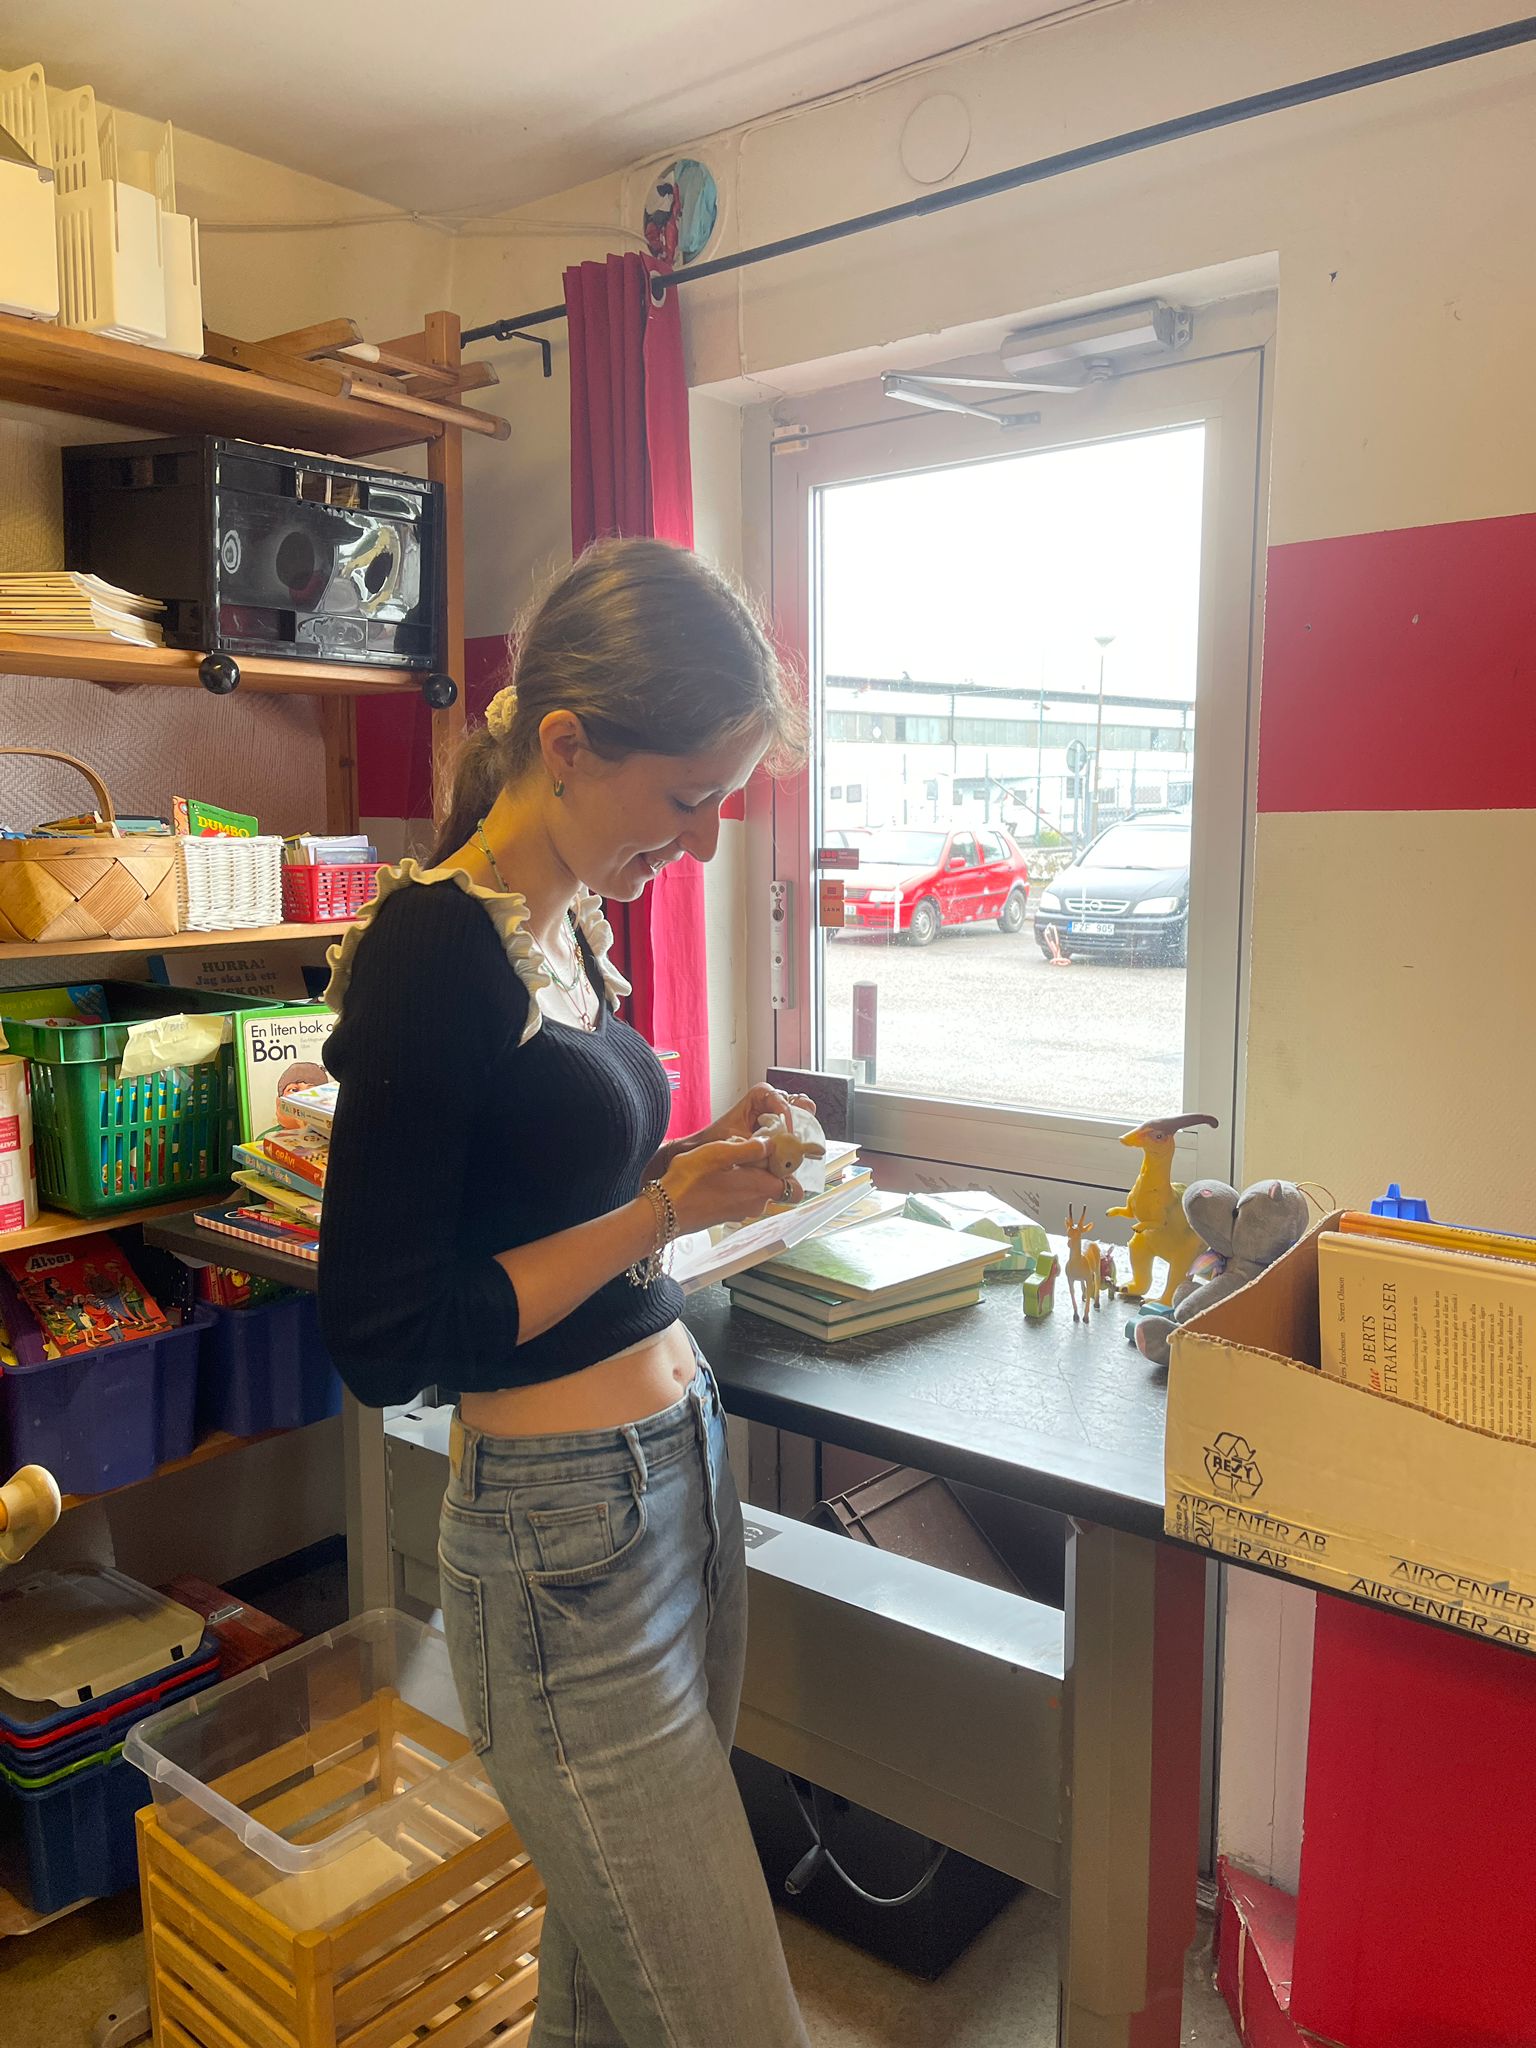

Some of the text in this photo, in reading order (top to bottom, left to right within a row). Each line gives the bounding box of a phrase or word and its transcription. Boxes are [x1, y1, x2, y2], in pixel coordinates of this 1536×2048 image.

[197, 815, 250, 838] DUMBO
[202, 959, 265, 972] HURRA!
[251, 1025, 267, 1038] En
[270, 1023, 297, 1036] liten
[299, 1020, 323, 1034] bok
[252, 1039, 297, 1063] Bön
[1362, 1315, 1376, 1364] BERTS
[1382, 1282, 1397, 1395] ETRAKTELSER
[1294, 1530, 1328, 1553] AB
[1257, 1549, 1289, 1569] AB
[1389, 1560, 1535, 1617] AIRCENTER
[1350, 1577, 1489, 1633] AIRCENTER
[1493, 1624, 1531, 1646] AB
